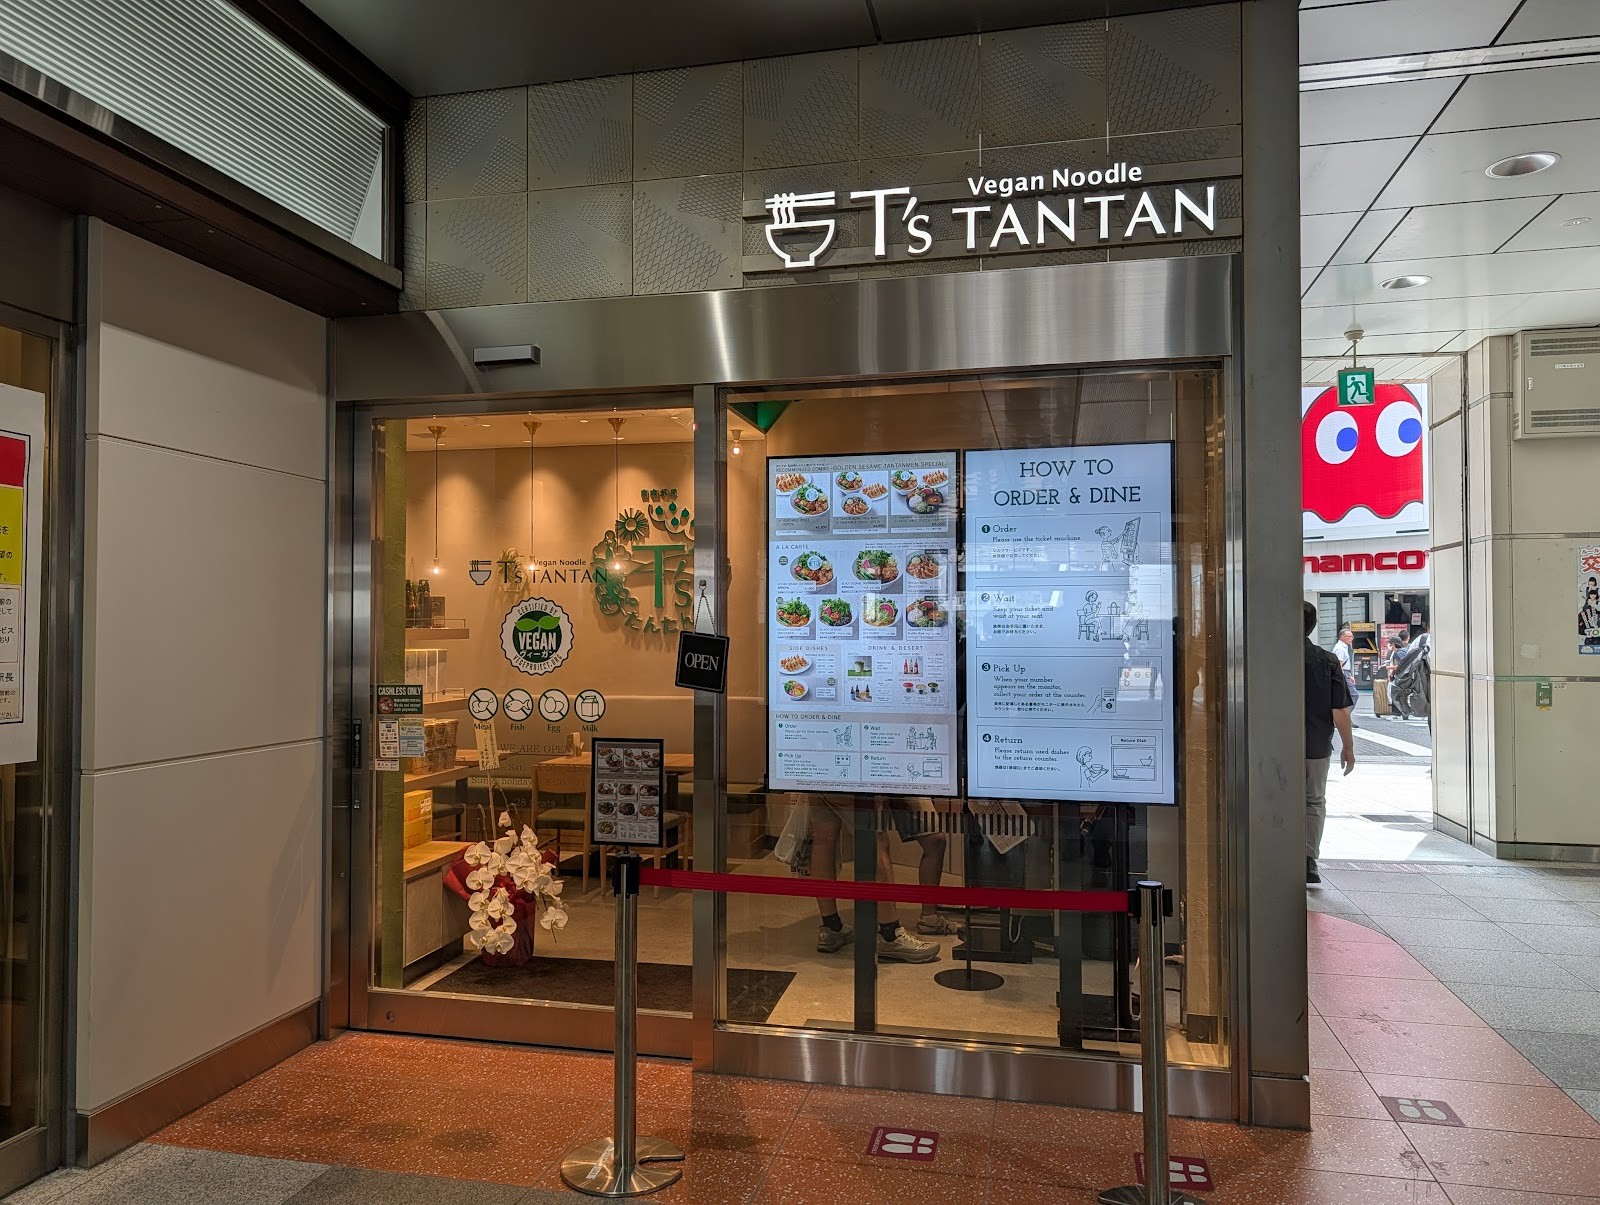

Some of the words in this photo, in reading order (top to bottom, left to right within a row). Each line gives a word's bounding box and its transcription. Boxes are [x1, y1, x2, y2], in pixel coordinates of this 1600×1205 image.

[967, 176, 1045, 197] Vegan
[1052, 164, 1142, 188] Noodle
[850, 187, 932, 258] T's
[952, 186, 1215, 250] TANTAN
[1020, 460, 1076, 478] HOW
[1084, 459, 1113, 476] TO
[994, 489, 1060, 506] ORDER
[1069, 487, 1081, 504] &
[1090, 486, 1141, 504] DINE
[992, 524, 1017, 533] Order
[534, 559, 558, 567] Vegan
[1303, 550, 1426, 573] namco
[496, 561, 523, 584] T's
[529, 569, 607, 584] TANTAN
[632, 544, 694, 608] T's
[993, 593, 1015, 602] Wait
[517, 602, 548, 616] CERTIFIED
[549, 606, 559, 616] BY
[518, 631, 557, 651] VEGAN
[513, 653, 563, 671] VEGEPROJECT.ORG
[685, 652, 720, 673] OPEN
[993, 664, 1010, 673] Pick
[1013, 664, 1026, 674] Up
[378, 686, 407, 696] CASHLESS
[407, 686, 422, 696] ONLY
[510, 723, 525, 731] Fish
[547, 724, 561, 733] Egg
[581, 724, 599, 733] Milk
[994, 735, 1023, 744] Return
[500, 744, 516, 753] WE
[519, 744, 540, 753] ARE
[543, 745, 572, 754] OPEN
[994, 746, 1012, 754] Please
[471, 776, 489, 784] Sun
[515, 798, 527, 807] 28
